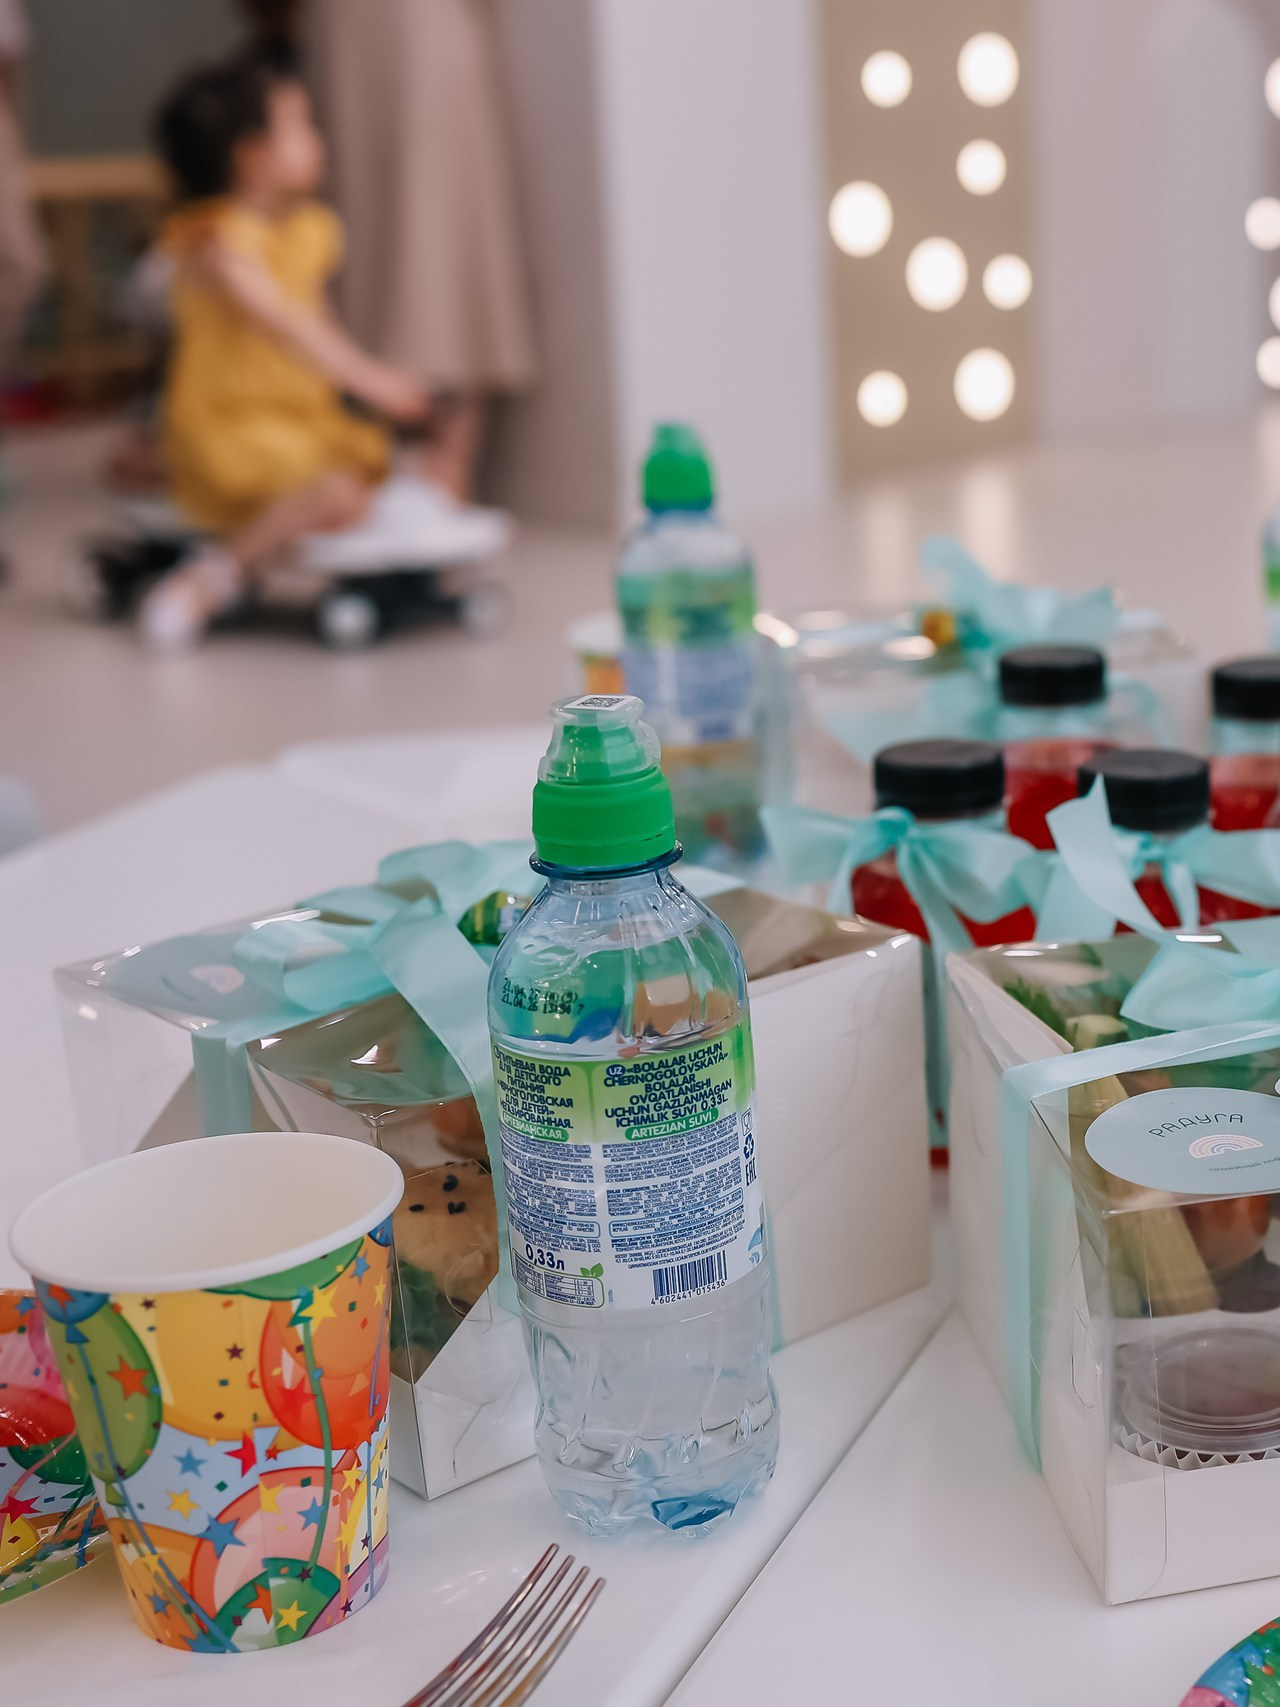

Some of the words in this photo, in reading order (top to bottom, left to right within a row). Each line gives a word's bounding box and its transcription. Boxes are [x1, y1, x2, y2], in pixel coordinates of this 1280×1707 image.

[539, 1064, 571, 1077] ВОДА
[608, 1066, 623, 1075] UZ
[688, 1042, 723, 1062] UCHUN
[507, 1075, 545, 1094] ПИТАНИЯ
[514, 1068, 561, 1086] ДЕТСКОГО
[644, 1074, 696, 1094] BOLALAR
[604, 1104, 650, 1118] UCHUN
[653, 1079, 732, 1112] GAZLANMAGAN
[629, 1078, 711, 1106] OVQATLANISHI
[616, 1111, 669, 1128] ICHIMLIK
[672, 1104, 697, 1119] SUVI
[631, 1120, 686, 1139] ARTEZIAN
[689, 1111, 716, 1125] SUVI.
[1148, 1113, 1243, 1138] РАДУГА
[525, 1243, 565, 1271] 0,33л
[659, 1290, 692, 1305] 602441
[696, 1279, 725, 1296] 015436
